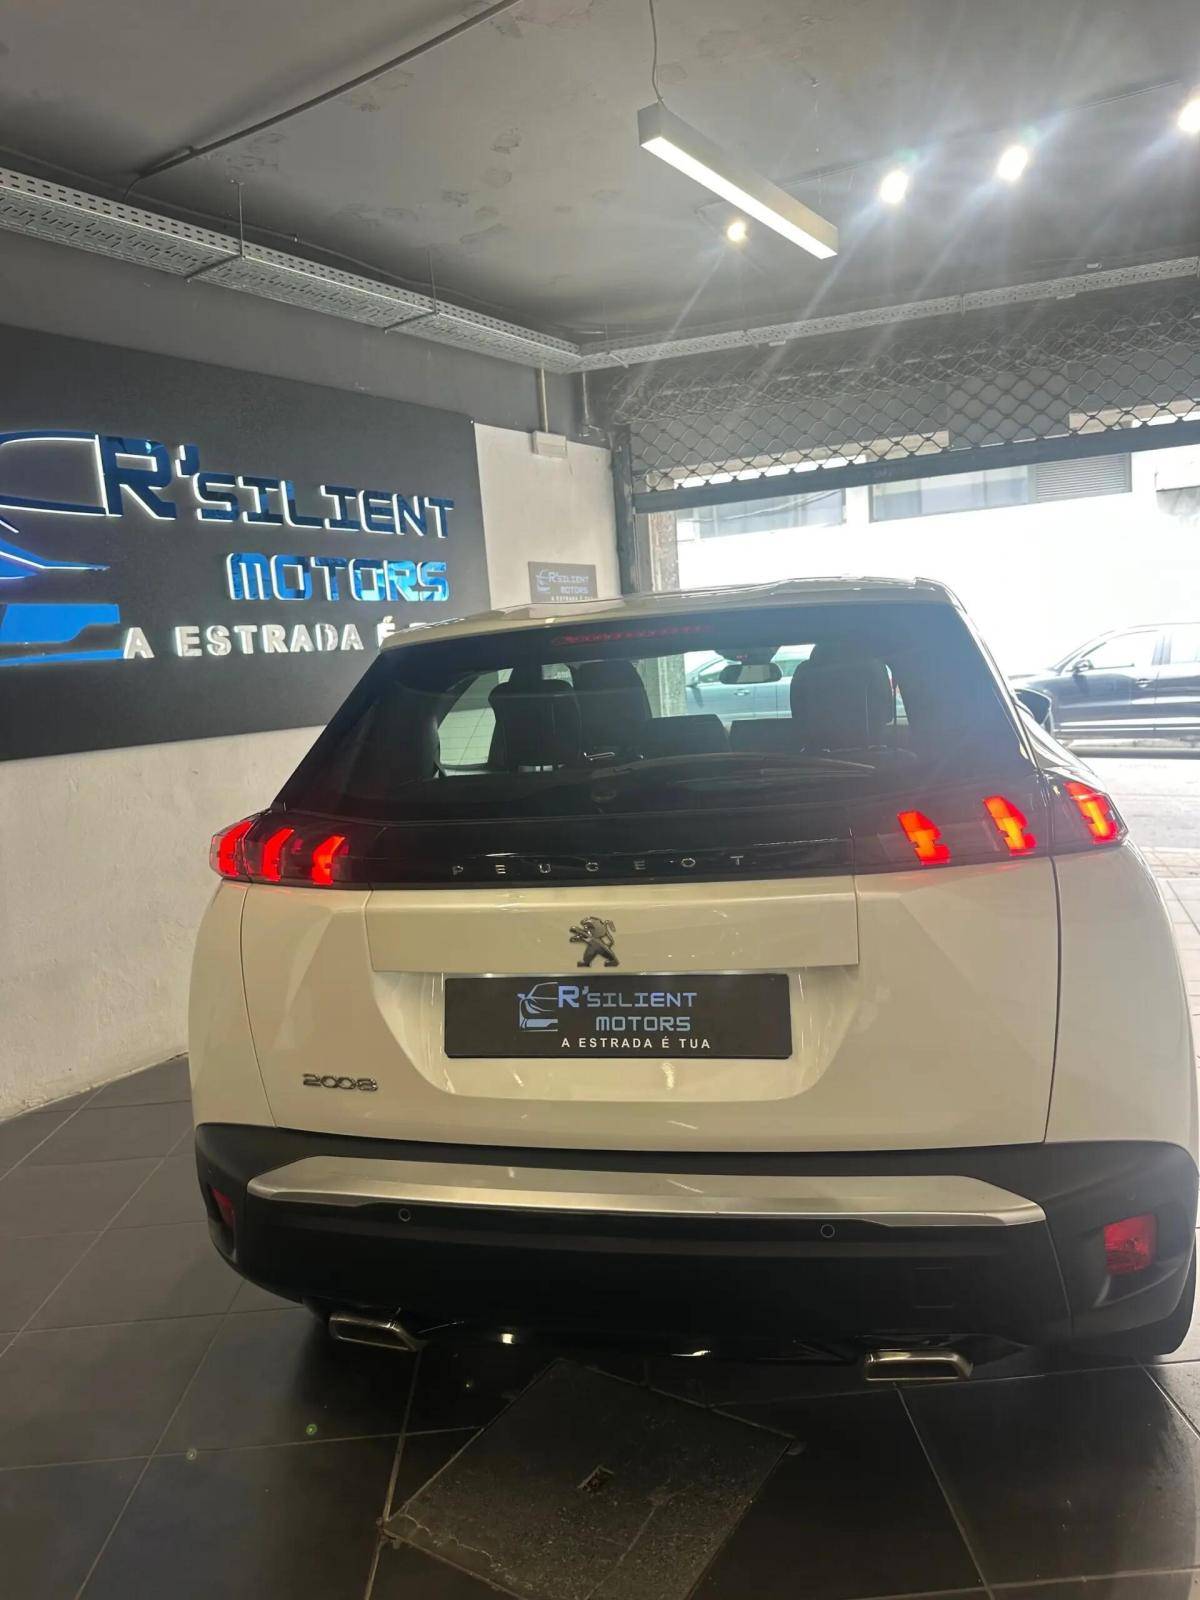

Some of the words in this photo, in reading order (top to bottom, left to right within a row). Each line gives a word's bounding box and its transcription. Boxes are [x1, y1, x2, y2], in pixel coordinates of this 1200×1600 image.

[95, 434, 455, 539] R'SILIENT
[226, 552, 450, 602] MOTORS
[123, 626, 154, 659] A
[175, 624, 364, 657] ESTRADA
[452, 855, 745, 876] PEUGEOT
[558, 985, 698, 1008] R'SILIENT
[595, 1016, 691, 1031] MOTORS
[561, 1038, 570, 1048] A
[579, 1038, 652, 1048] ESTRADA
[662, 1036, 669, 1048] É
[679, 1038, 710, 1048] TUA
[302, 1073, 378, 1092] 2008
